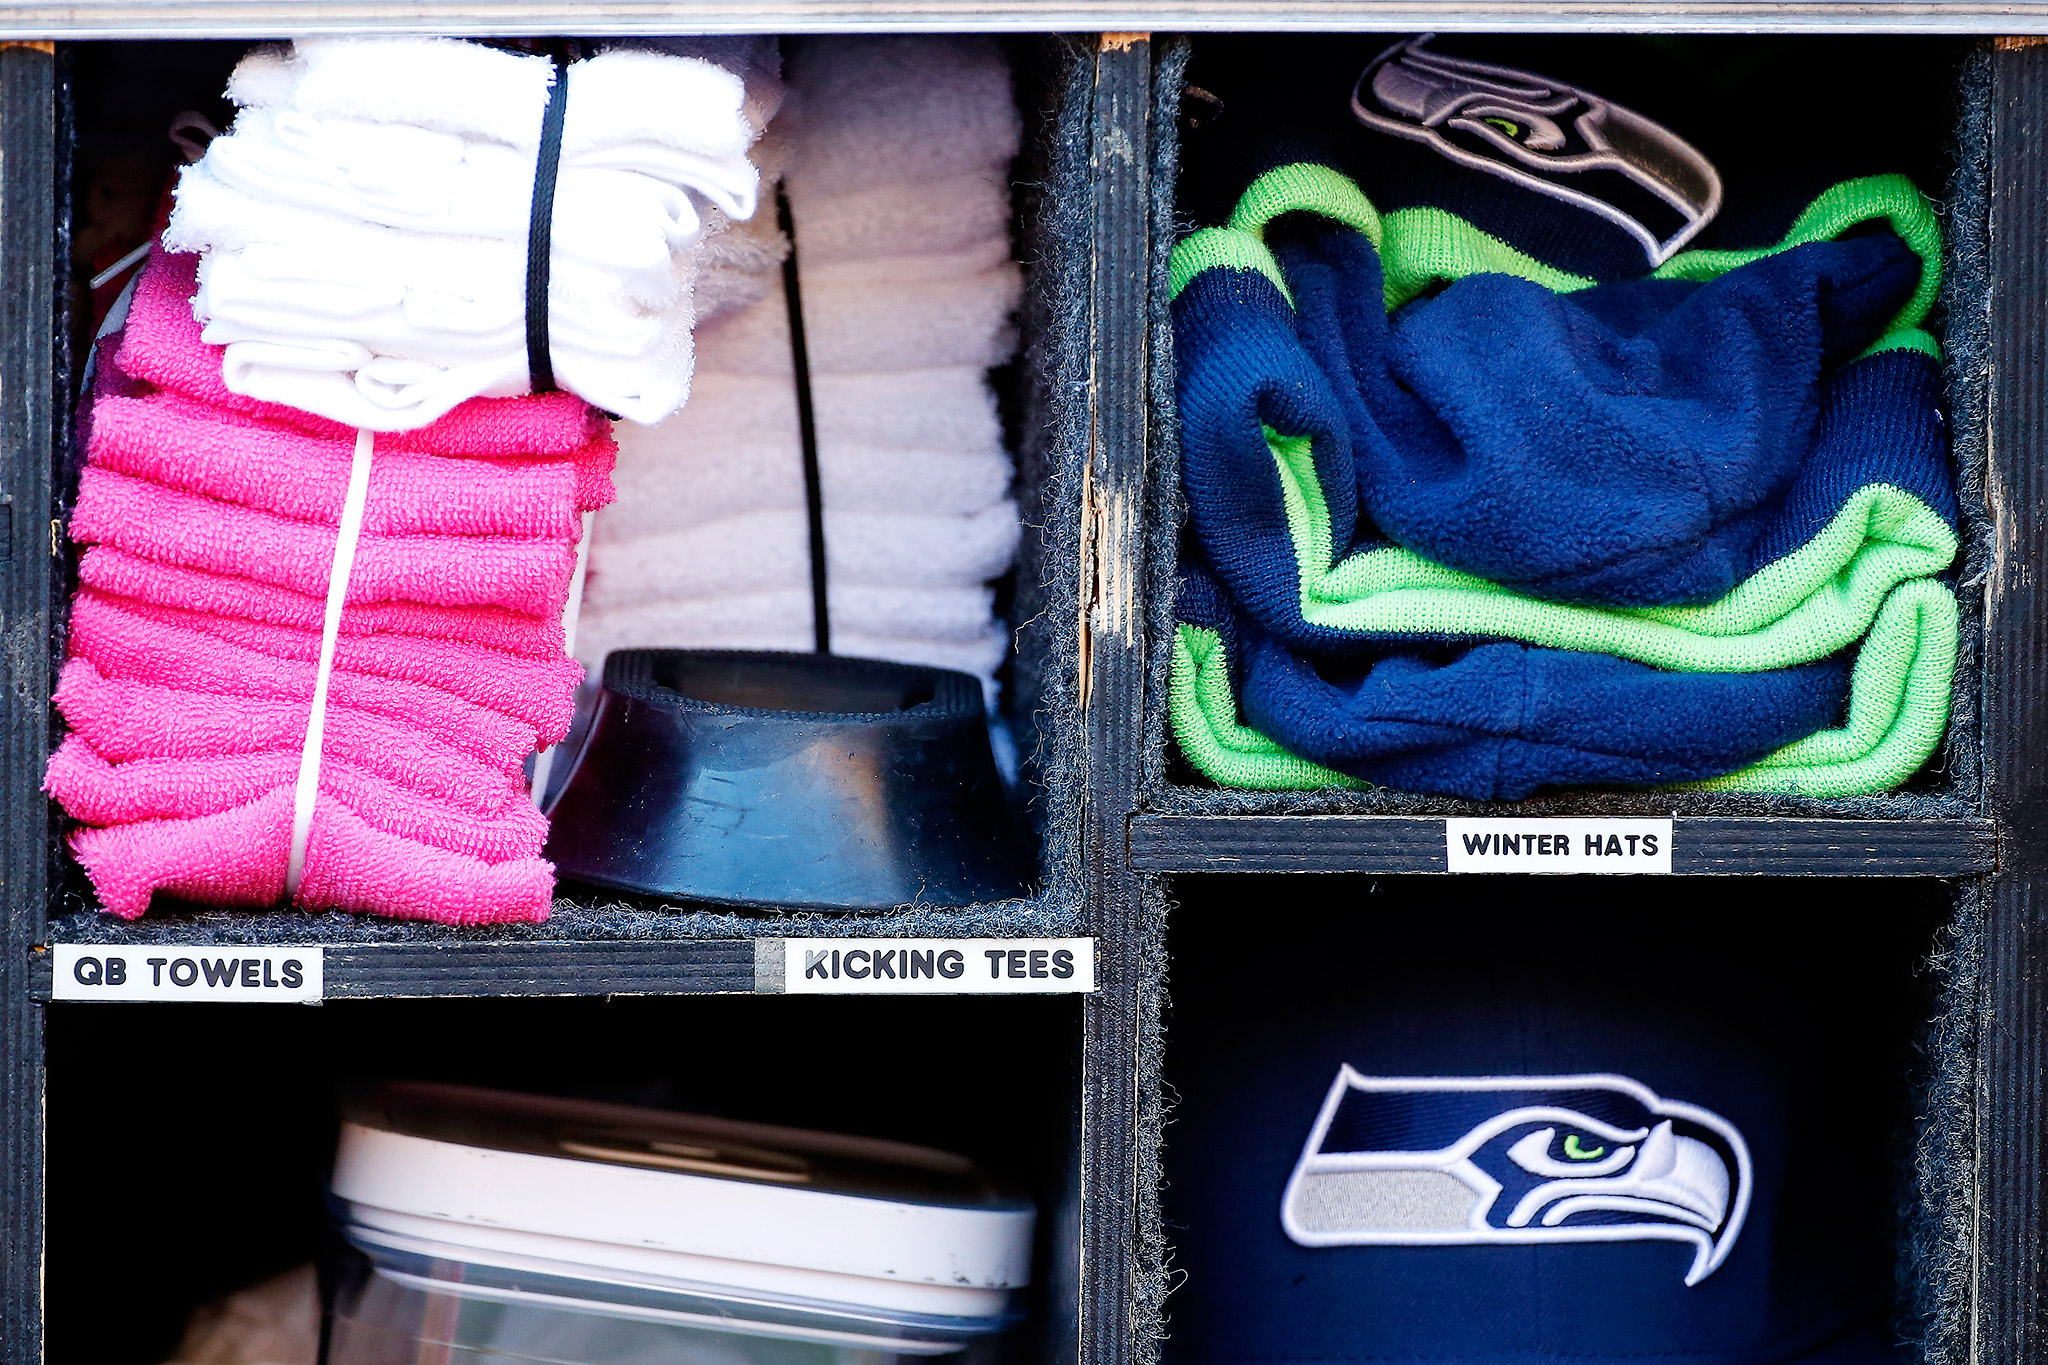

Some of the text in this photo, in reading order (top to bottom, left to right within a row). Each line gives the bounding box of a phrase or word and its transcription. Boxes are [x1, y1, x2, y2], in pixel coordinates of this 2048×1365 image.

[1462, 833, 1659, 857] WINTER HATS
[73, 956, 304, 989] QB TOWELS
[805, 949, 1075, 980] KICKING TEES
